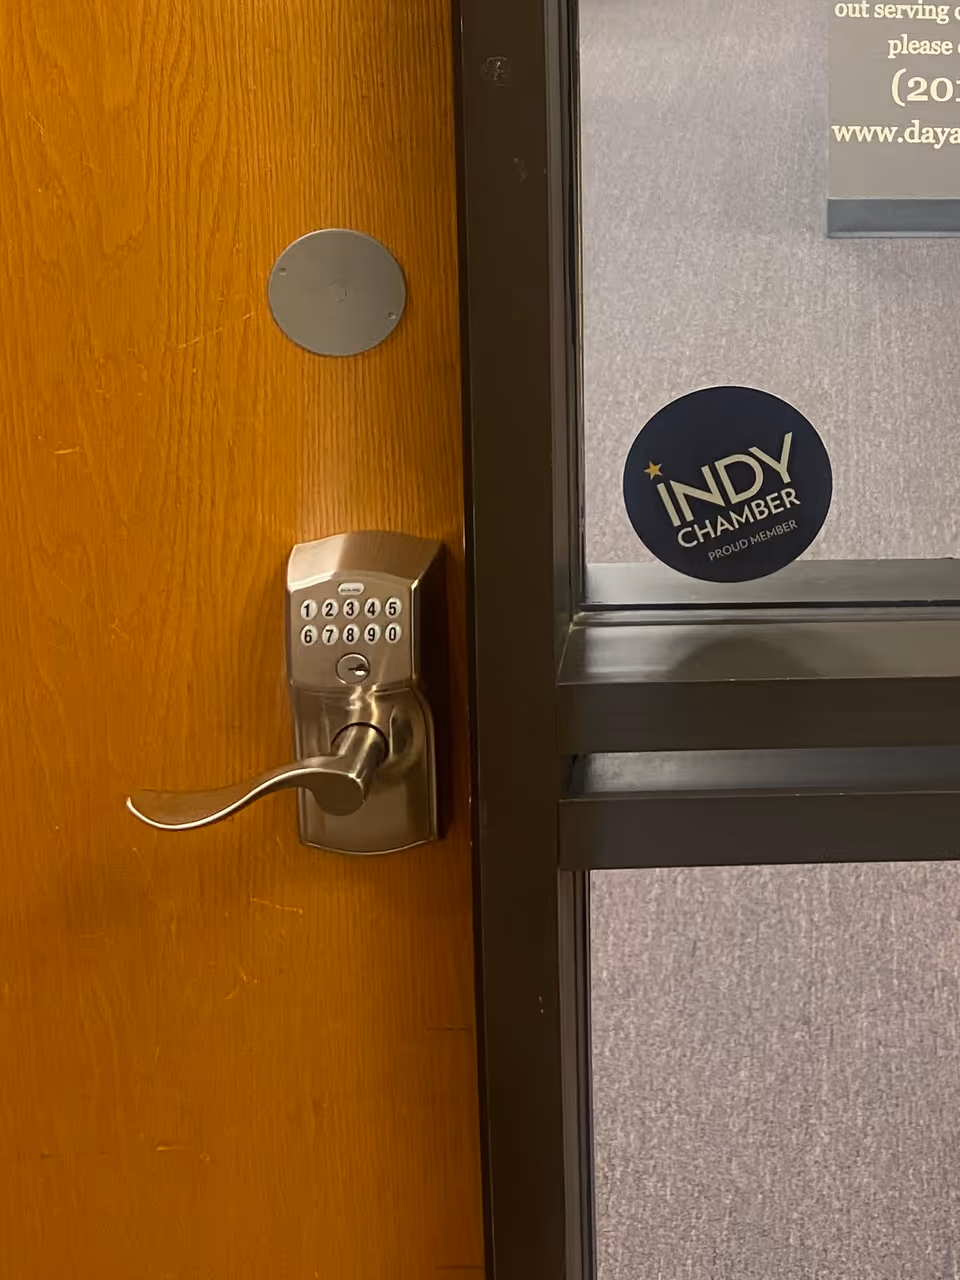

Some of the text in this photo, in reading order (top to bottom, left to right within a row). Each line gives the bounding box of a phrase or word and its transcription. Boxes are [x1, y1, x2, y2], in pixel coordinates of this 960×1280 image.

[834, 0, 870, 17] out
[874, 0, 950, 24] serving
[888, 33, 953, 59] please
[677, 487, 801, 548] CHAMBER
[708, 519, 798, 561] PROUD MEMBER
[303, 602, 397, 617] 1 2 3 4 5
[304, 627, 397, 643] 6 7 8 9 0
